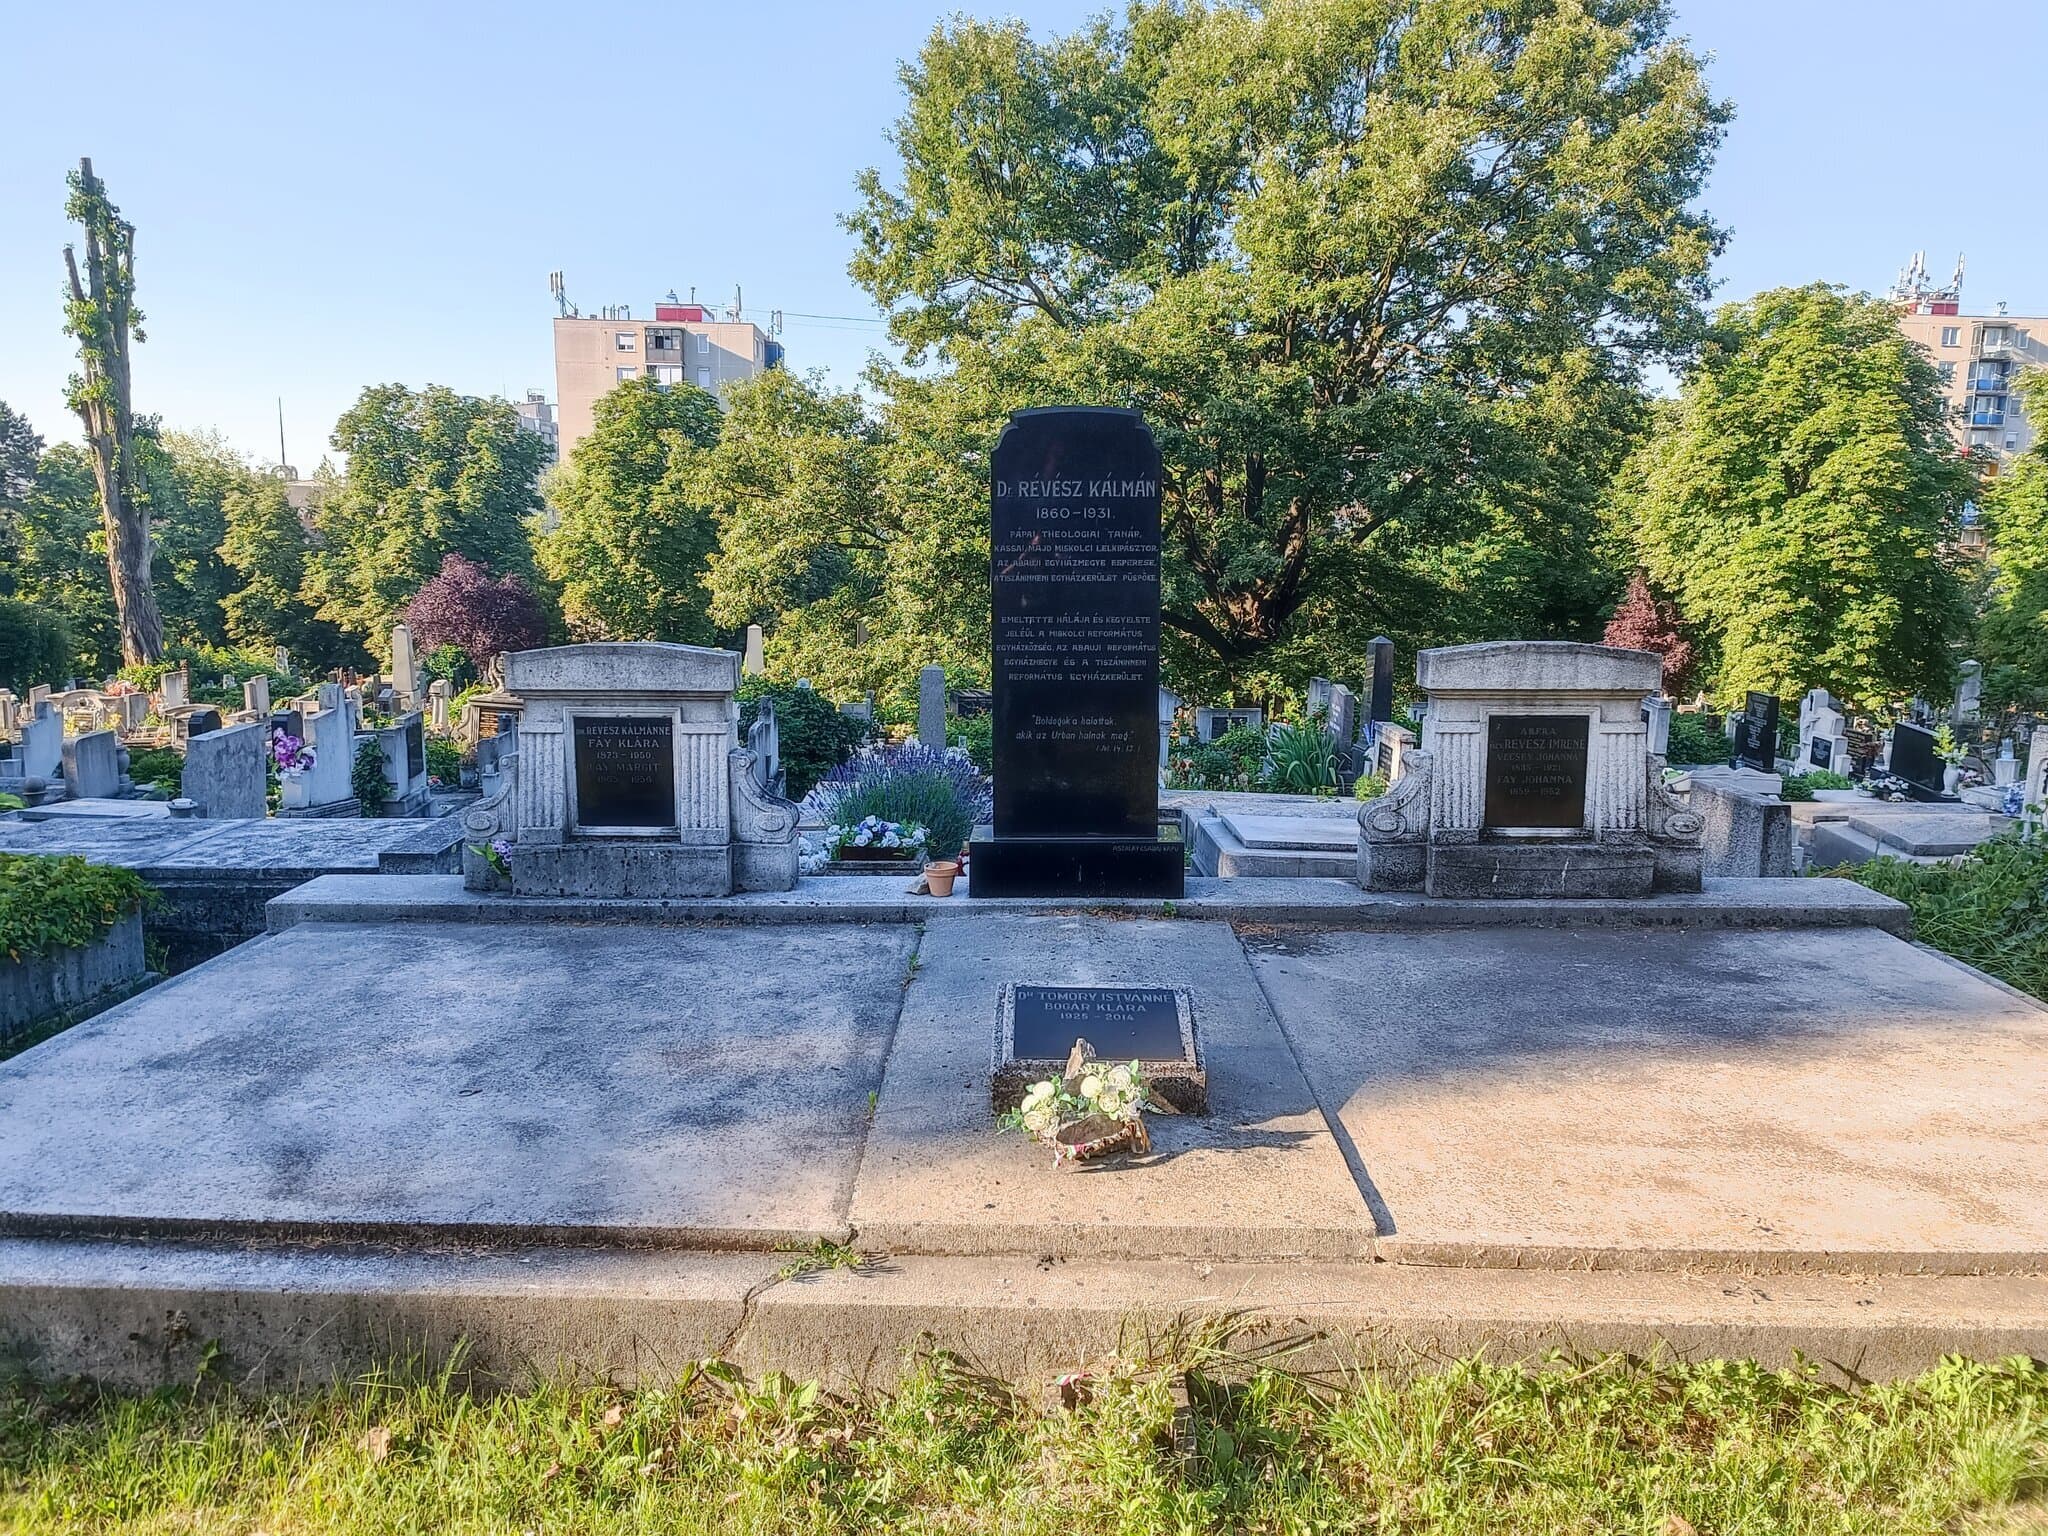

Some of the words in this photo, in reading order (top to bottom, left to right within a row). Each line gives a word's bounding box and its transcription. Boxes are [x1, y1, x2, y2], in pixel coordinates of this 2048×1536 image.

[1018, 472, 1083, 498] RÉVÉSZ
[1089, 472, 1156, 498] KÁLMÁN
[1042, 530, 1100, 539] THEOLOGIAI
[1055, 544, 1093, 552] MISKOLCI
[1045, 555, 1106, 567] EGYHÁZMEGYE
[1056, 611, 1090, 624] HÁLÁJA
[1092, 612, 1104, 624] ÉS
[1038, 630, 1045, 638] A
[1048, 630, 1085, 638] MISKOLCI
[1087, 627, 1143, 638] REFORMÁTUS
[1056, 644, 1069, 652] AZ
[1082, 658, 1089, 666] A
[1008, 670, 1063, 681] REFORMÁTUS
[621, 722, 671, 736] KÁLMÁNNÉ
[588, 736, 612, 748] FÁY
[618, 736, 660, 748] KLÁRA
[1044, 1000, 1091, 1012] BOGÁR
[1096, 1000, 1147, 1013] KLÁRA
[1105, 1013, 1135, 1021] 2014
